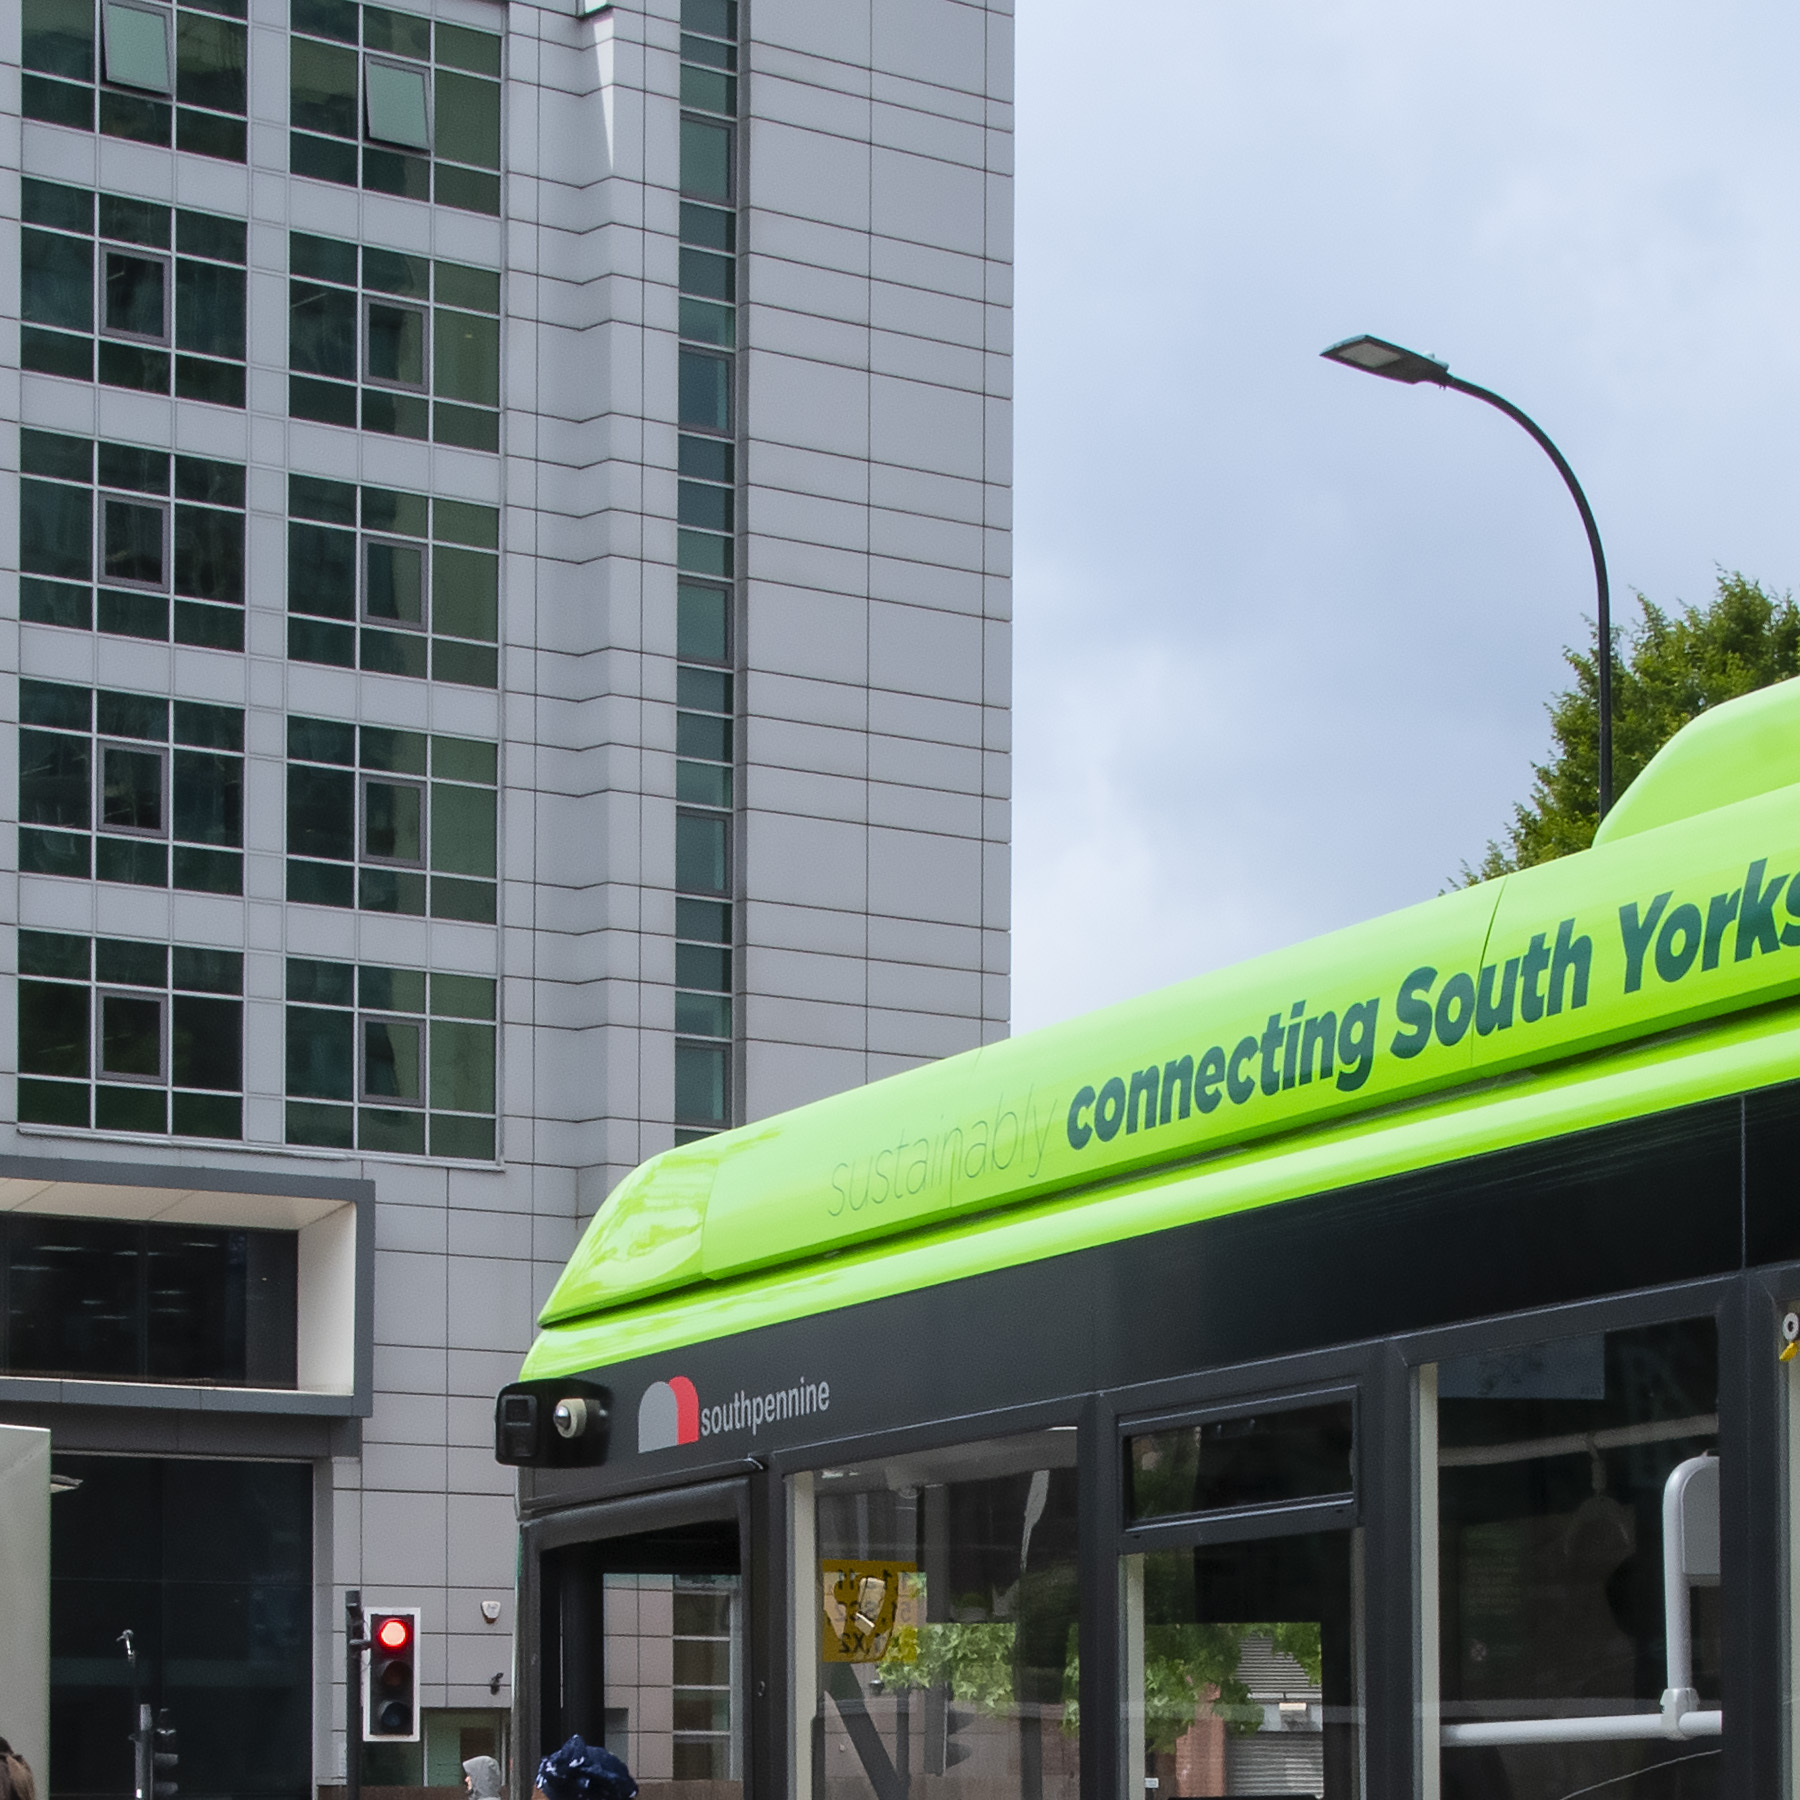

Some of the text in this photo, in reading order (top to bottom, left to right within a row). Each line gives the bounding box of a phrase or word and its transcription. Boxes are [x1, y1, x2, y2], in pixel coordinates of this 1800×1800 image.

[827, 1083, 1058, 1217] sustainably
[1067, 997, 1380, 1150] connecting
[1389, 917, 1593, 1060] South
[701, 1376, 830, 1436] southpennine
